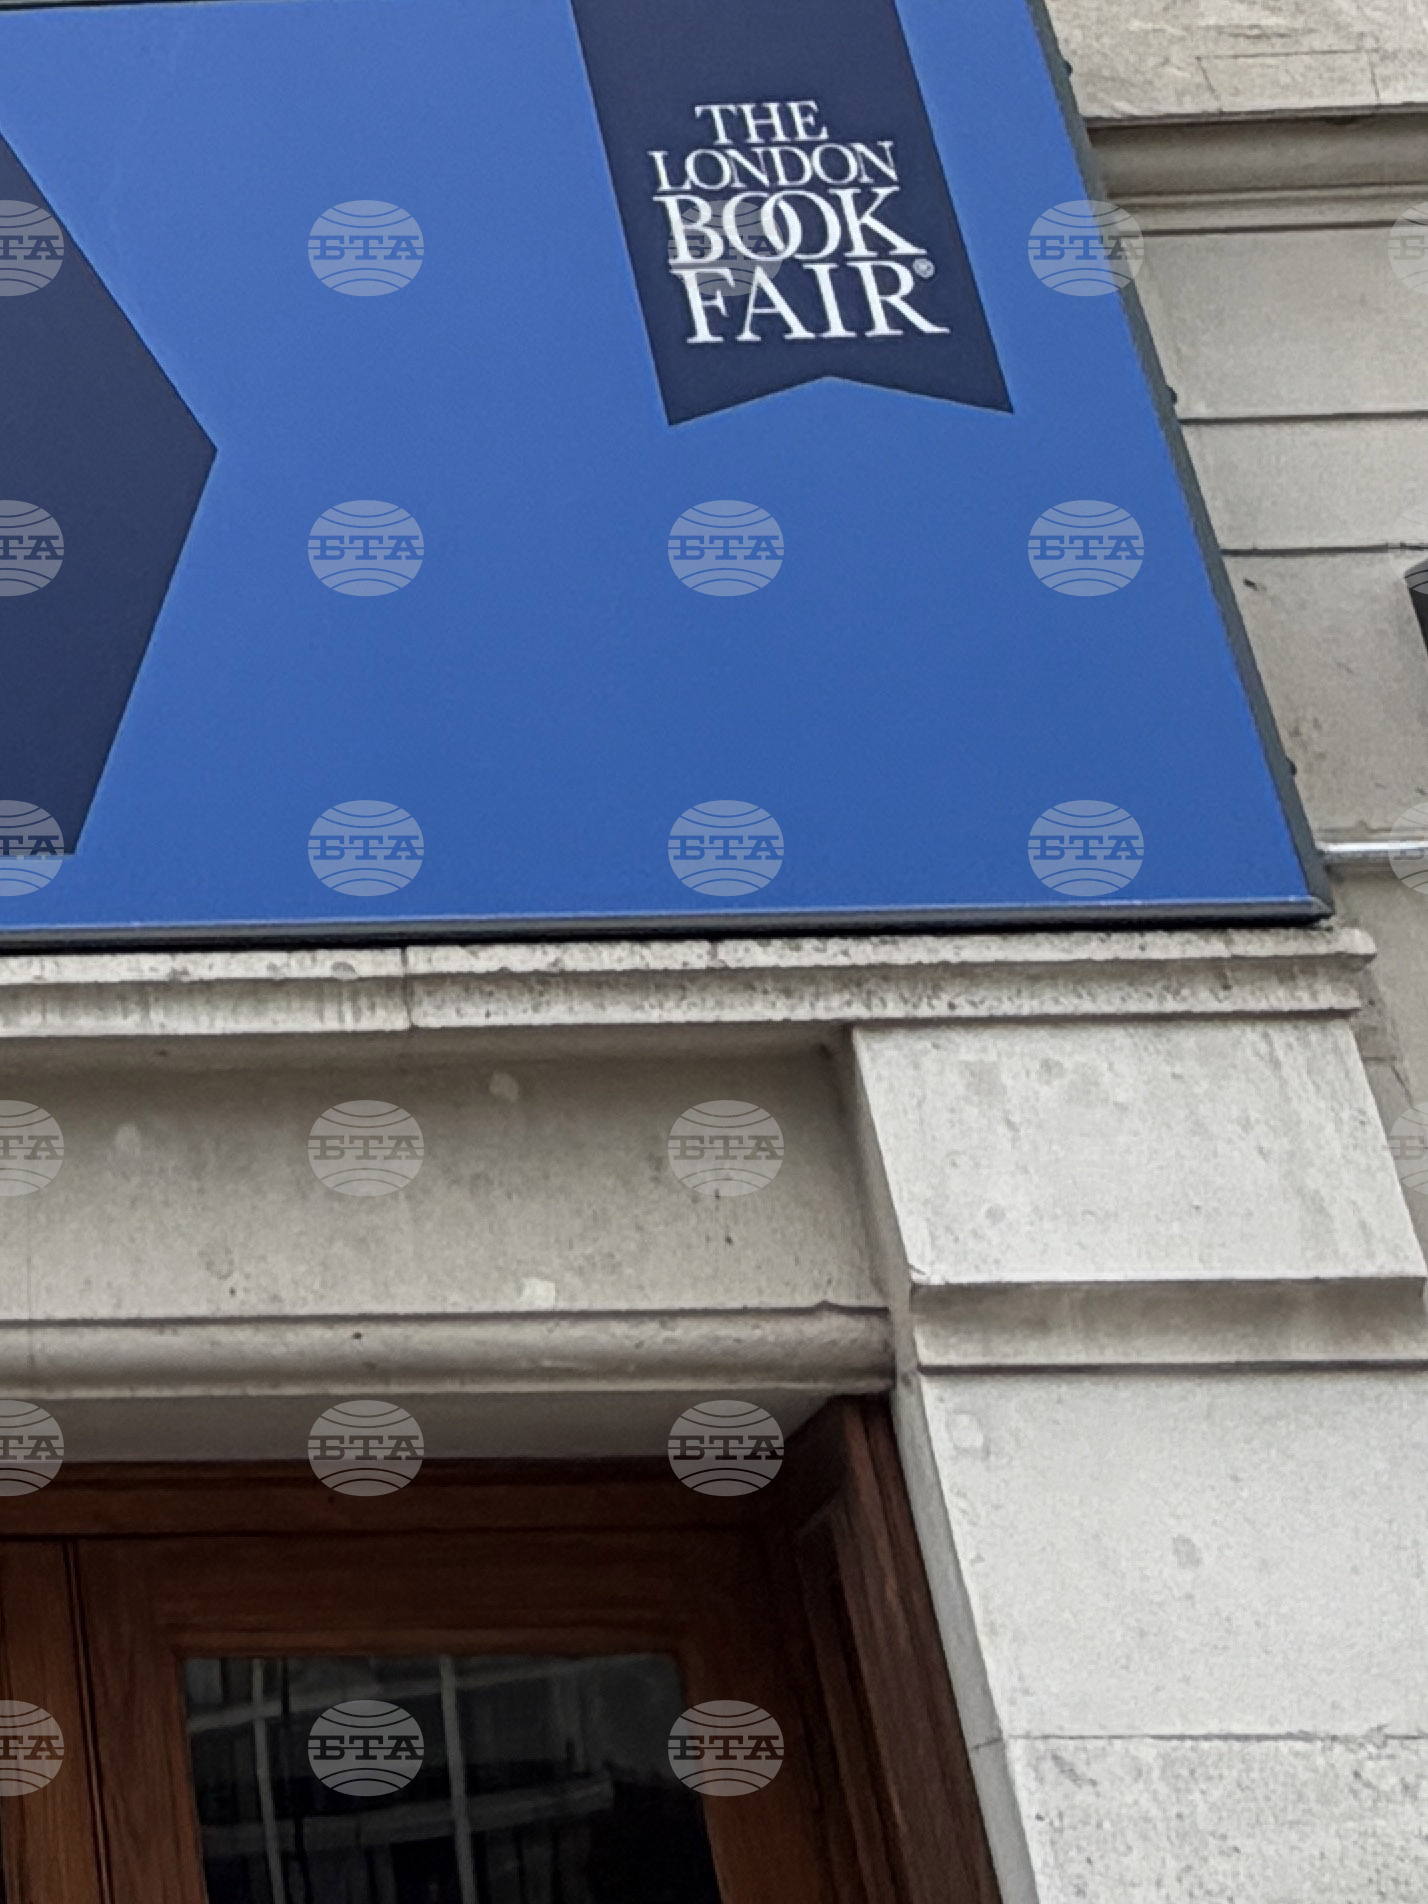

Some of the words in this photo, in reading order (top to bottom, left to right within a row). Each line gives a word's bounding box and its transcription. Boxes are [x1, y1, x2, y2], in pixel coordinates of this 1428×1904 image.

[694, 99, 829, 145] THE
[646, 140, 900, 191] LONDON
[651, 186, 929, 267] BOOK
[668, 259, 951, 344] FAIR
